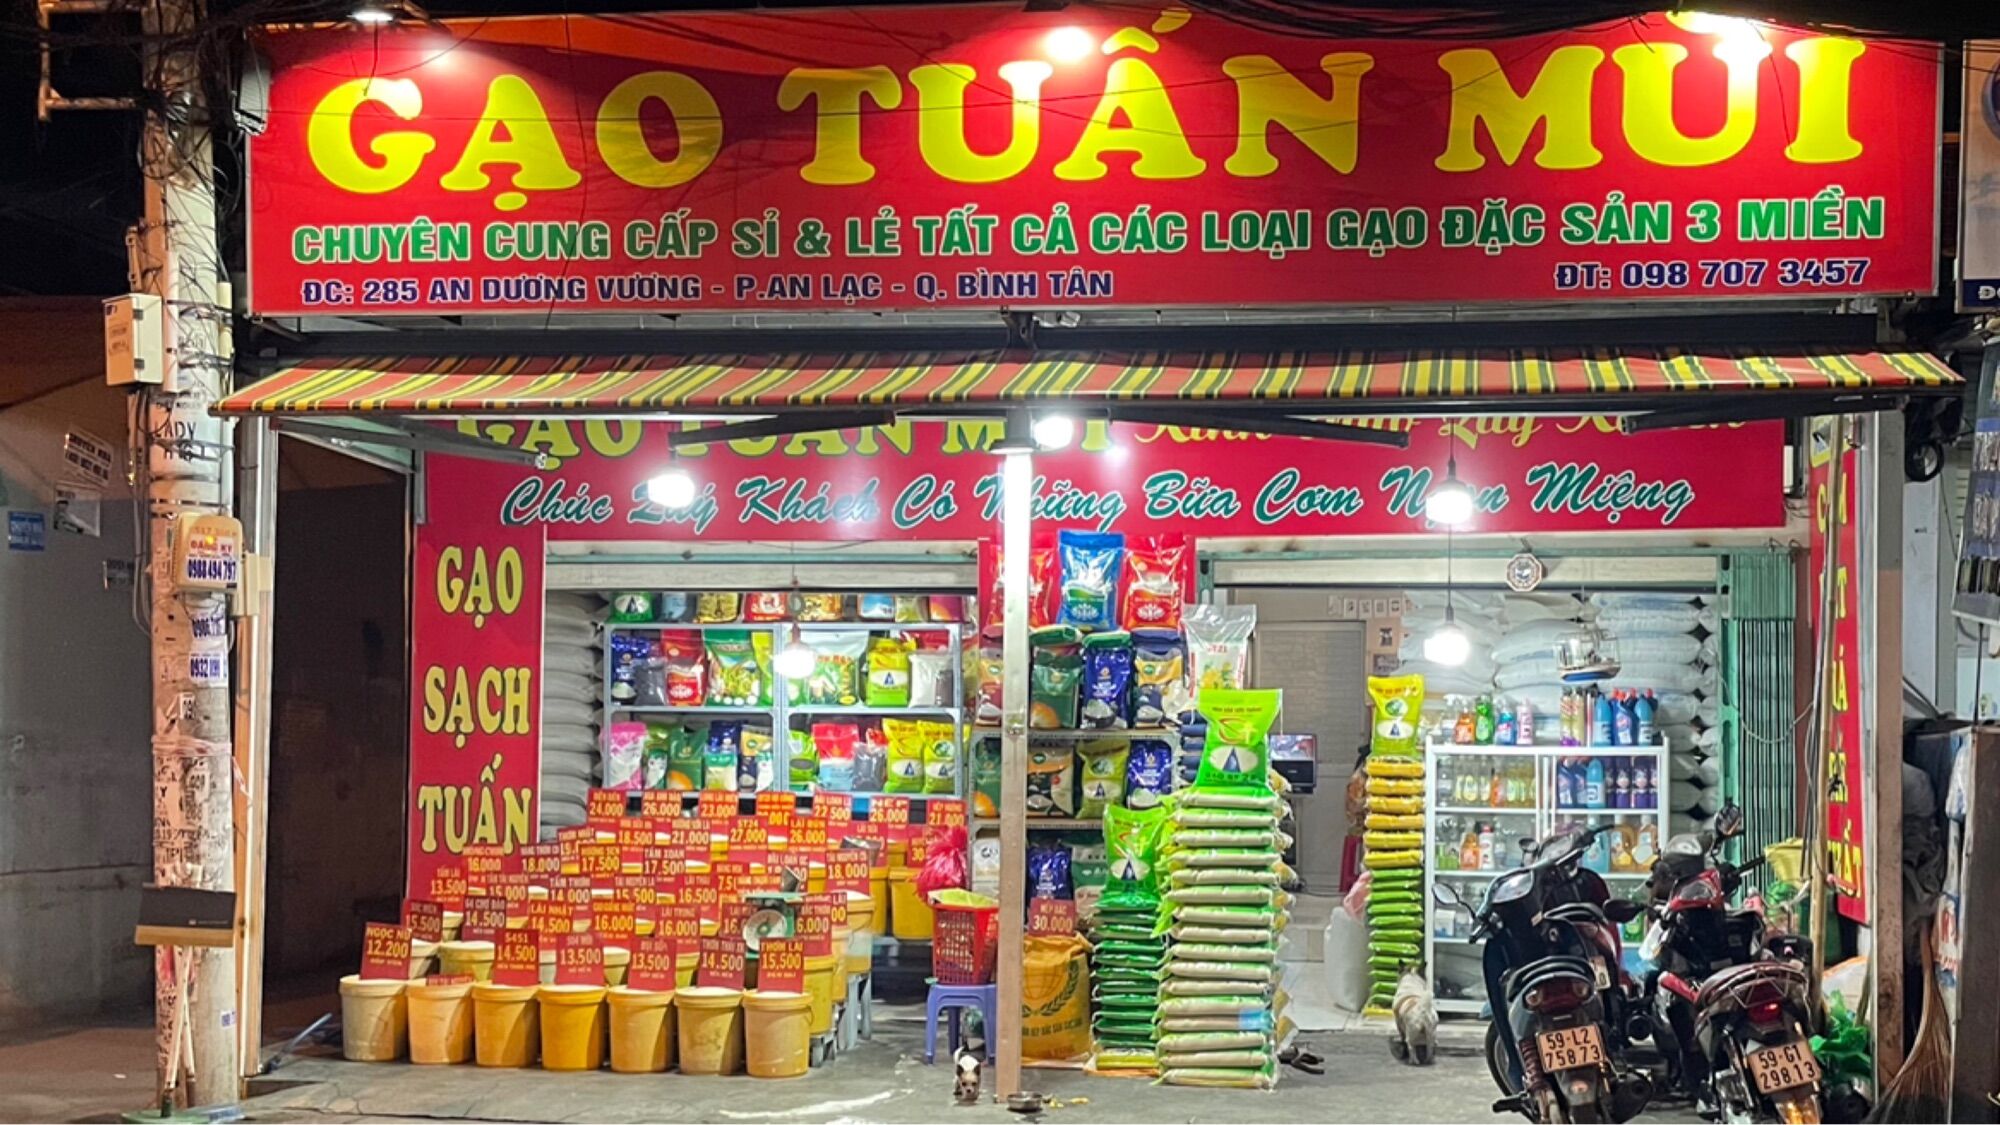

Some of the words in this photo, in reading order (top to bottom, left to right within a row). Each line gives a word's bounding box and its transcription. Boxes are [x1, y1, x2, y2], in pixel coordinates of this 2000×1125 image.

[307, 70, 723, 212] GẠO
[777, 8, 1375, 186] TUẤN
[292, 215, 470, 263] CHUYÊN
[484, 220, 610, 261] CUNG
[623, 209, 718, 260] CẤP
[732, 208, 779, 260] SỈ
[794, 217, 829, 257] &
[846, 206, 901, 257] LẺ
[914, 203, 998, 257] TẤT
[1011, 203, 1078, 254] CẢ
[1091, 206, 1187, 254] CÁC
[1204, 210, 1311, 260] LOẠI
[1328, 206, 1427, 257] GẠO
[1441, 197, 1546, 257] ĐẶC
[1560, 191, 1671, 246] SẢN
[1686, 201, 1720, 243] 3
[1738, 185, 1885, 242] MIỀN
[1554, 263, 1612, 290] ĐT:
[1621, 260, 1689, 289] 098
[1699, 259, 1767, 287] 707
[1777, 257, 1872, 287] 3457
[301, 279, 354, 305] ĐC:
[363, 279, 419, 303] 285
[429, 278, 473, 303] AN
[483, 277, 586, 302] DƯƠNG
[596, 275, 701, 302] VƯƠNG
[711, 286, 724, 295] -
[735, 275, 812, 301] P.AN
[821, 275, 883, 305] LẠC
[891, 284, 905, 293] -
[915, 273, 948, 303] Q.
[956, 267, 1038, 299] BÌNH
[1048, 267, 1114, 298] TÂN
[500, 475, 613, 526] Chúc
[738, 477, 879, 525] Khách
[893, 475, 956, 528] Có
[1144, 470, 1240, 520] Bữa
[1254, 468, 1364, 526] Cơm
[1526, 462, 1698, 527] Miệng
[436, 546, 523, 629] GẠO
[423, 665, 531, 749] SẠCH
[418, 752, 532, 855] TUẤN
[814, 805, 852, 821] 22500
[489, 886, 526, 901] 15000
[550, 889, 590, 904] 14000
[616, 888, 656, 904] 15500
[594, 915, 634, 932] 16.000
[797, 918, 829, 934] 6.000
[366, 939, 408, 958] 12.200
[497, 946, 536, 962] 14.500
[560, 949, 602, 966] 13.500
[632, 953, 670, 971] 13.500
[702, 952, 744, 972] 14.500
[1546, 1027, 1591, 1050] 59-L2
